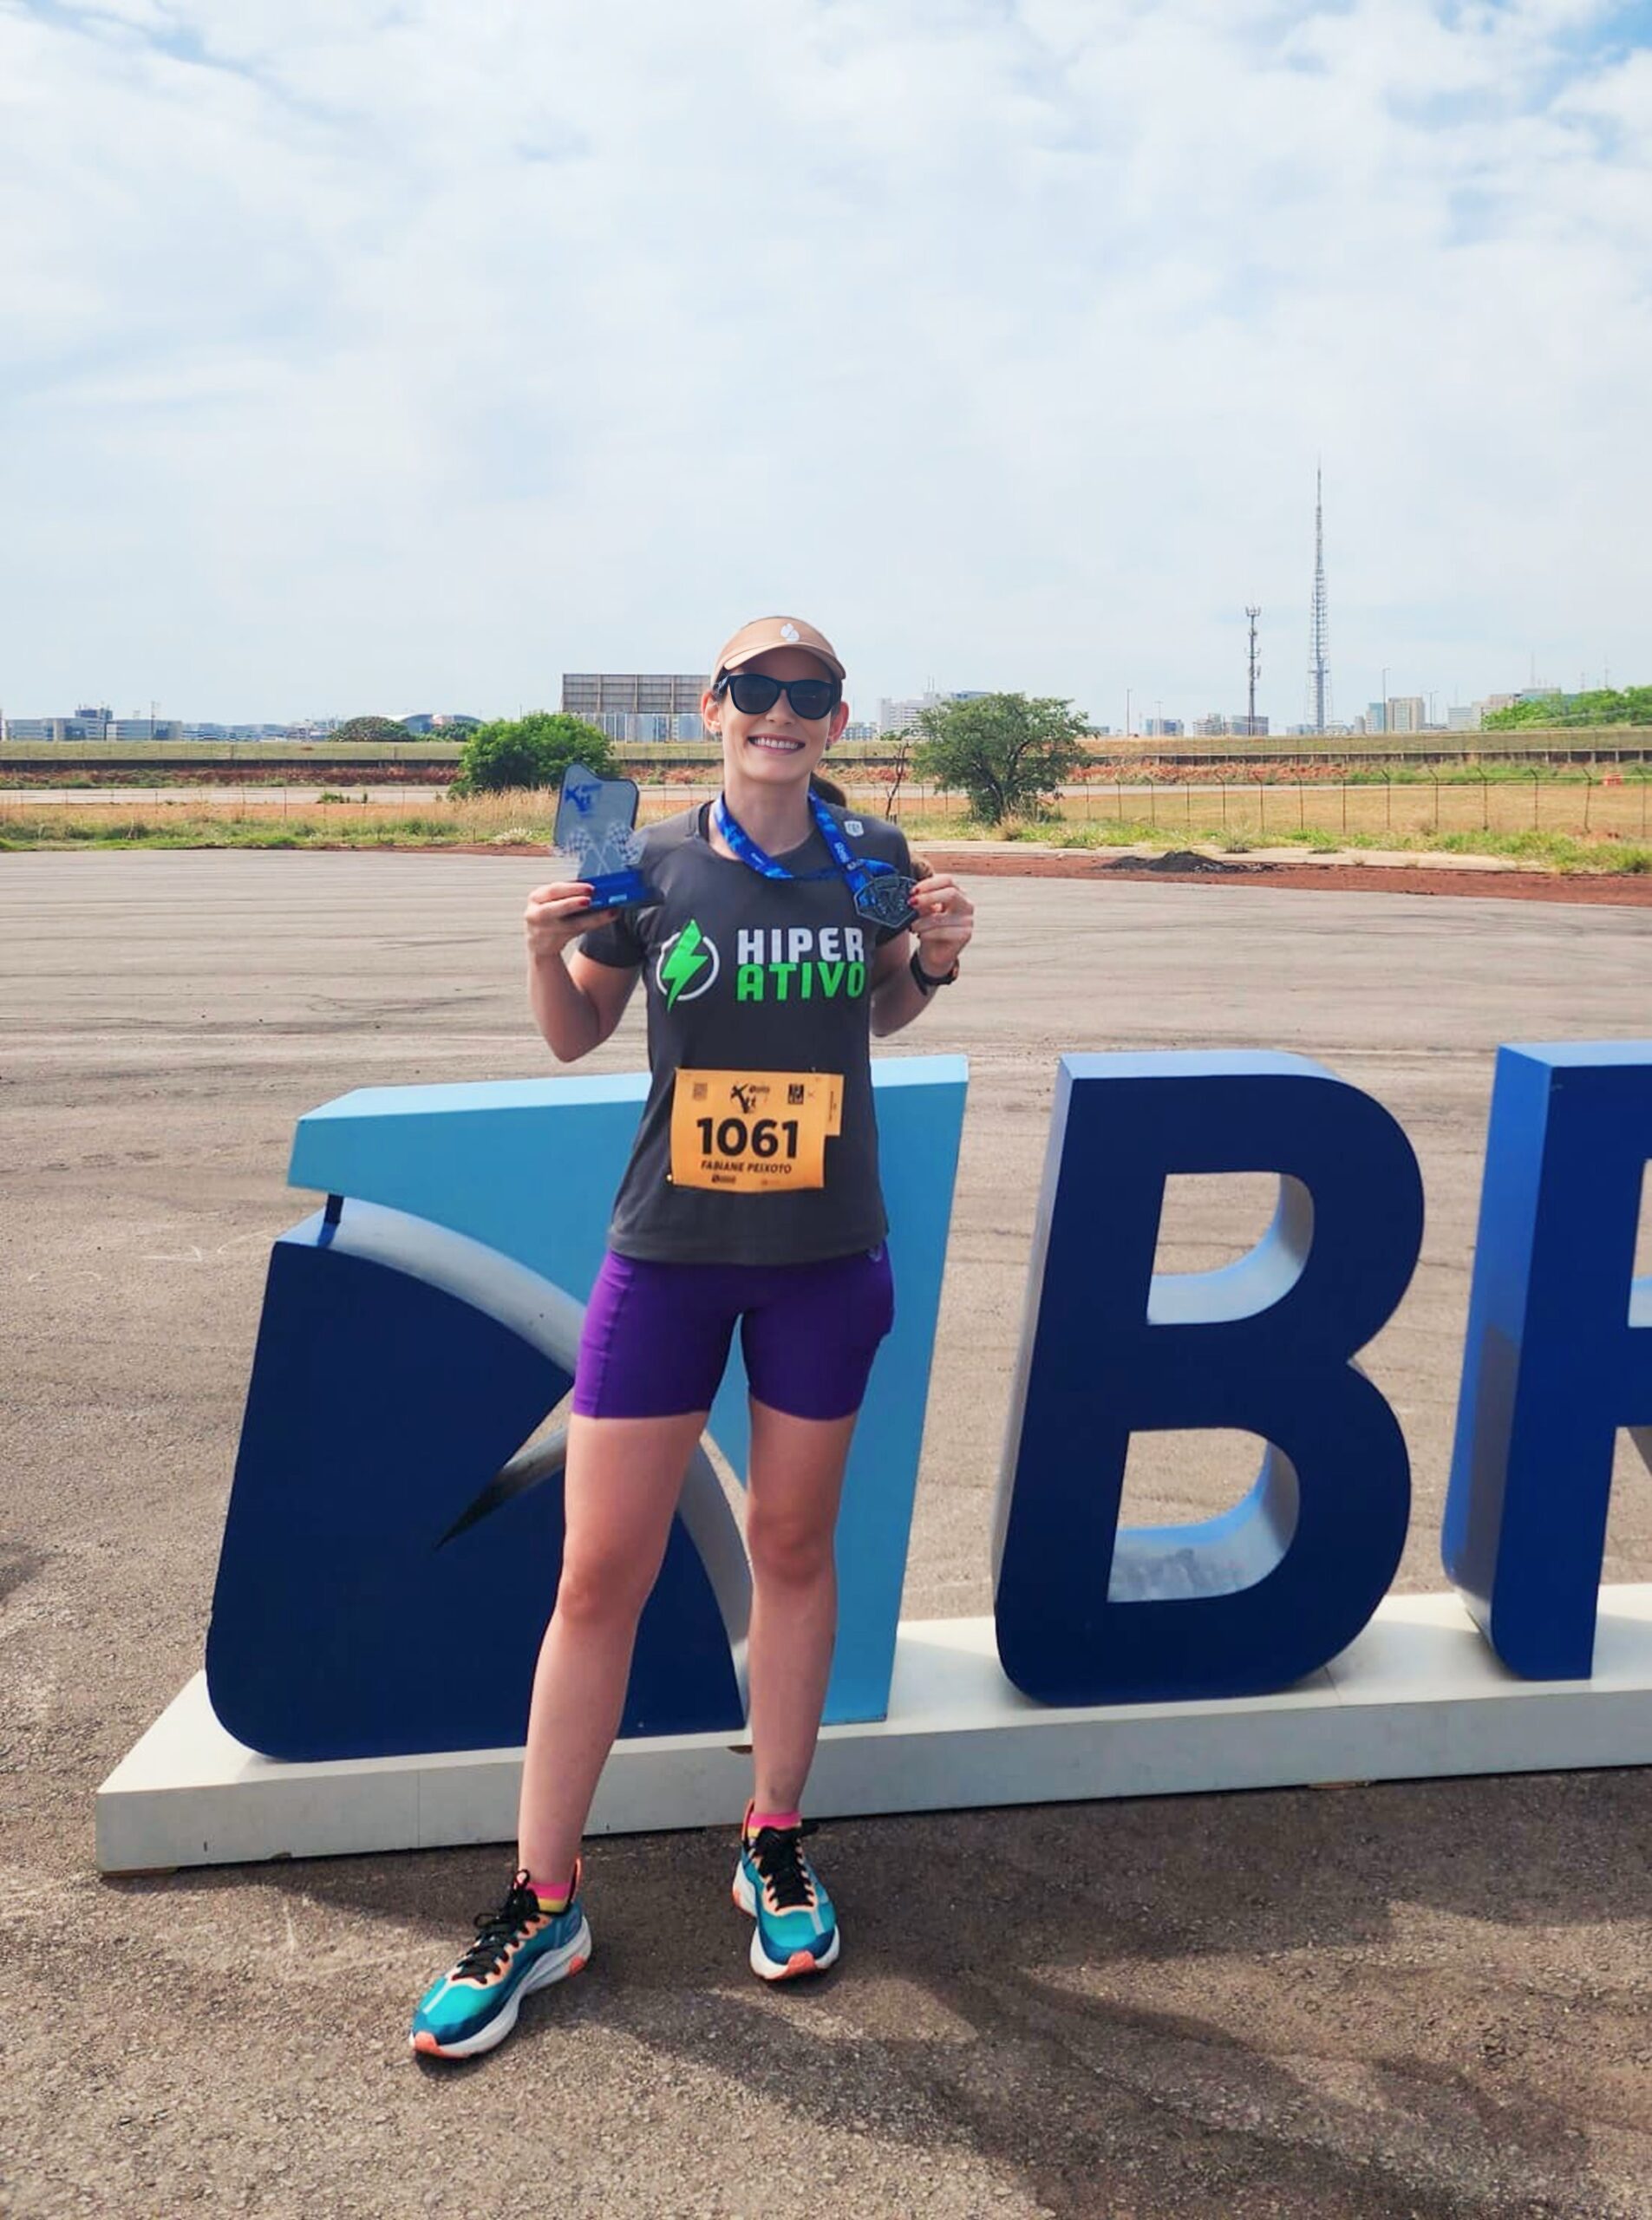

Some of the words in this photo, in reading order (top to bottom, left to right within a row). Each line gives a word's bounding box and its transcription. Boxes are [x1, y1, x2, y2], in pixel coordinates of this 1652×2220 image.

[737, 927, 864, 964] HIPER
[737, 962, 865, 1001] ATIVO
[696, 1117, 799, 1159] 1061
[701, 1159, 744, 1172] FABIANE
[747, 1163, 792, 1174] PEIXOTO
